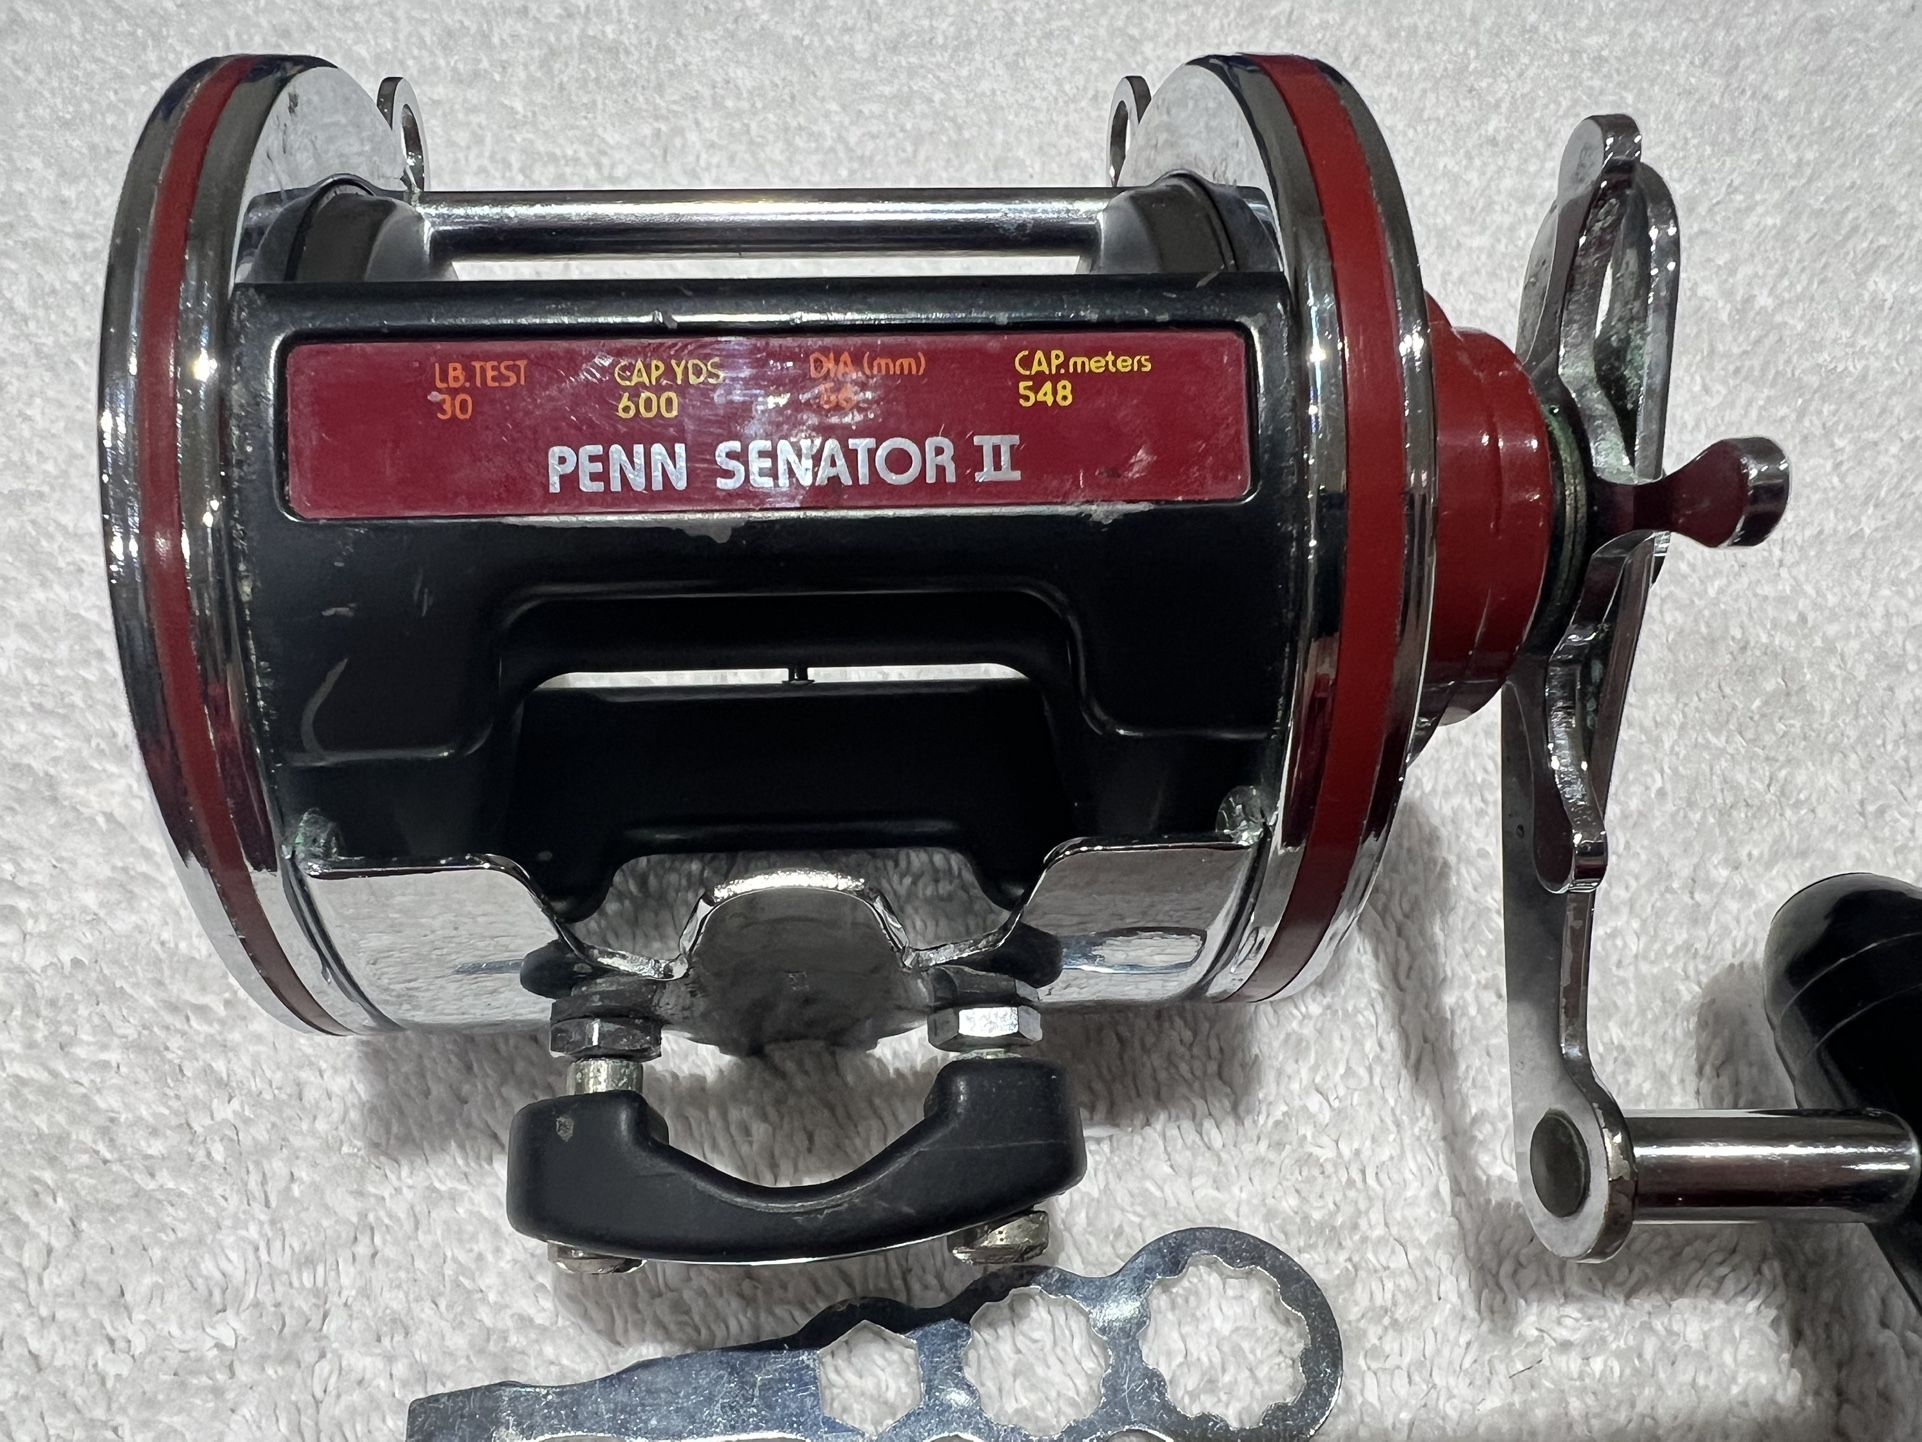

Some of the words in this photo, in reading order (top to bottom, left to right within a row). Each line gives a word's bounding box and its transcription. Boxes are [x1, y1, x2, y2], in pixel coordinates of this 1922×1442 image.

[436, 392, 473, 420] 30
[616, 390, 679, 419] 600
[1018, 379, 1073, 408] 548
[548, 442, 688, 493] PENN
[714, 436, 956, 490] SENATOR
[972, 434, 1022, 482] II
